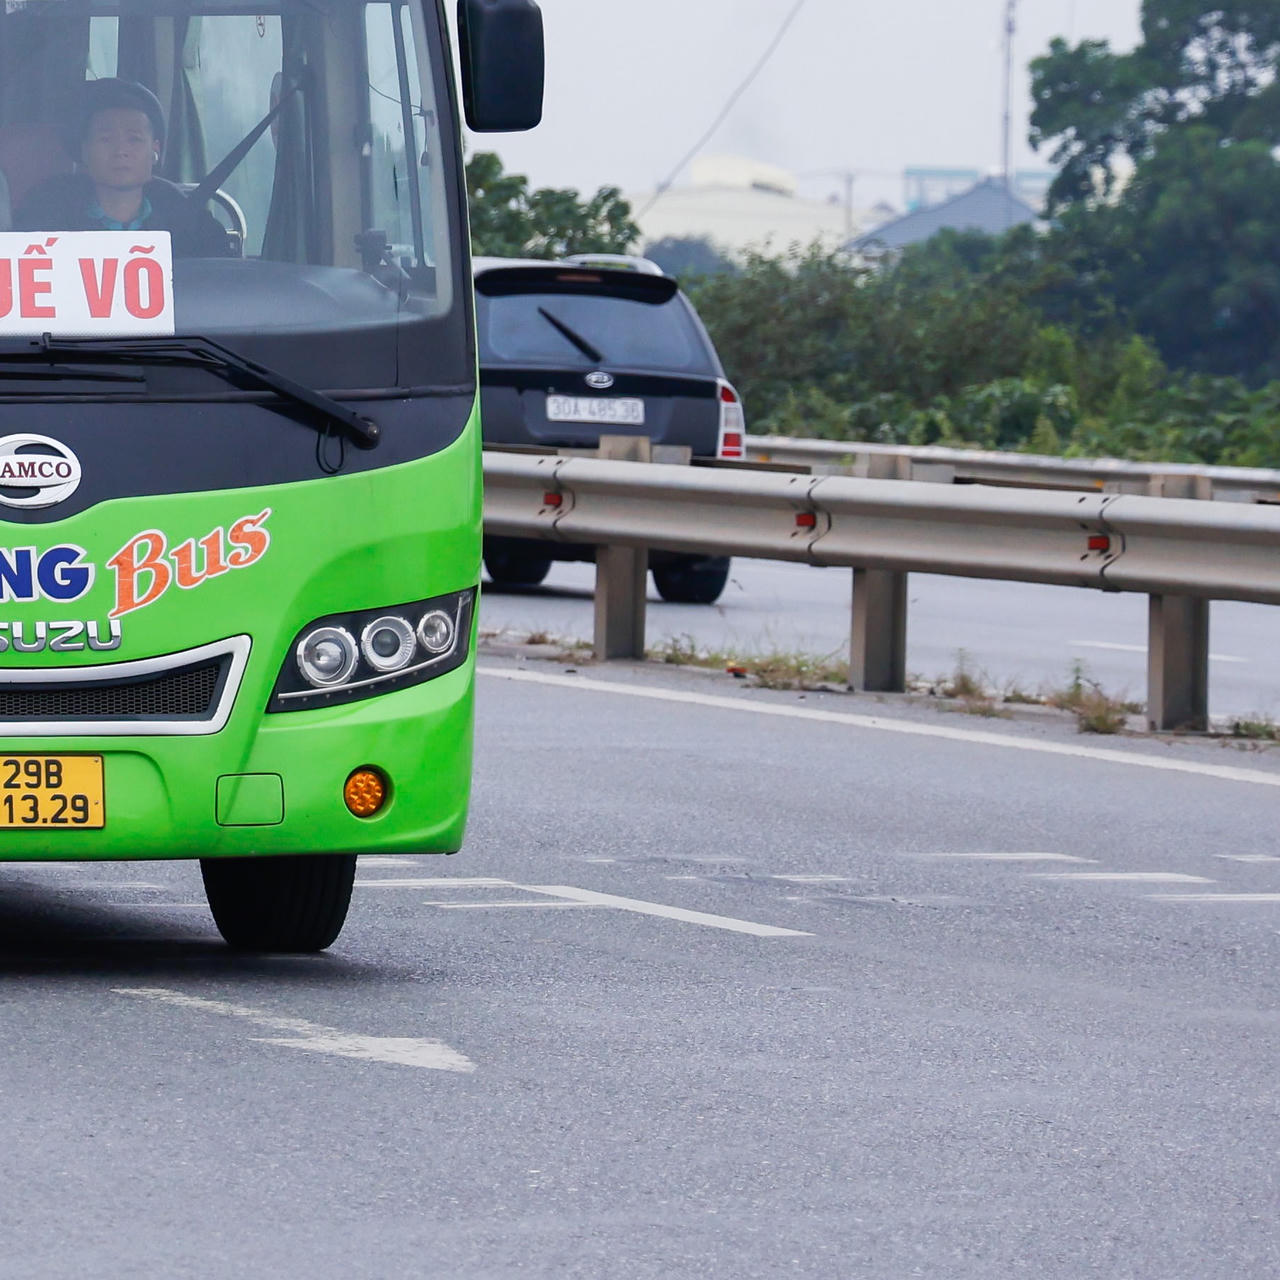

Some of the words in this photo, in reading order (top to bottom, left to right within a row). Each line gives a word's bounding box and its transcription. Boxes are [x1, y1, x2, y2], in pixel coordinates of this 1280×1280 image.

[79, 245, 165, 319] VÕ
[106, 509, 271, 619] Bus
[2, 759, 63, 789] 29B
